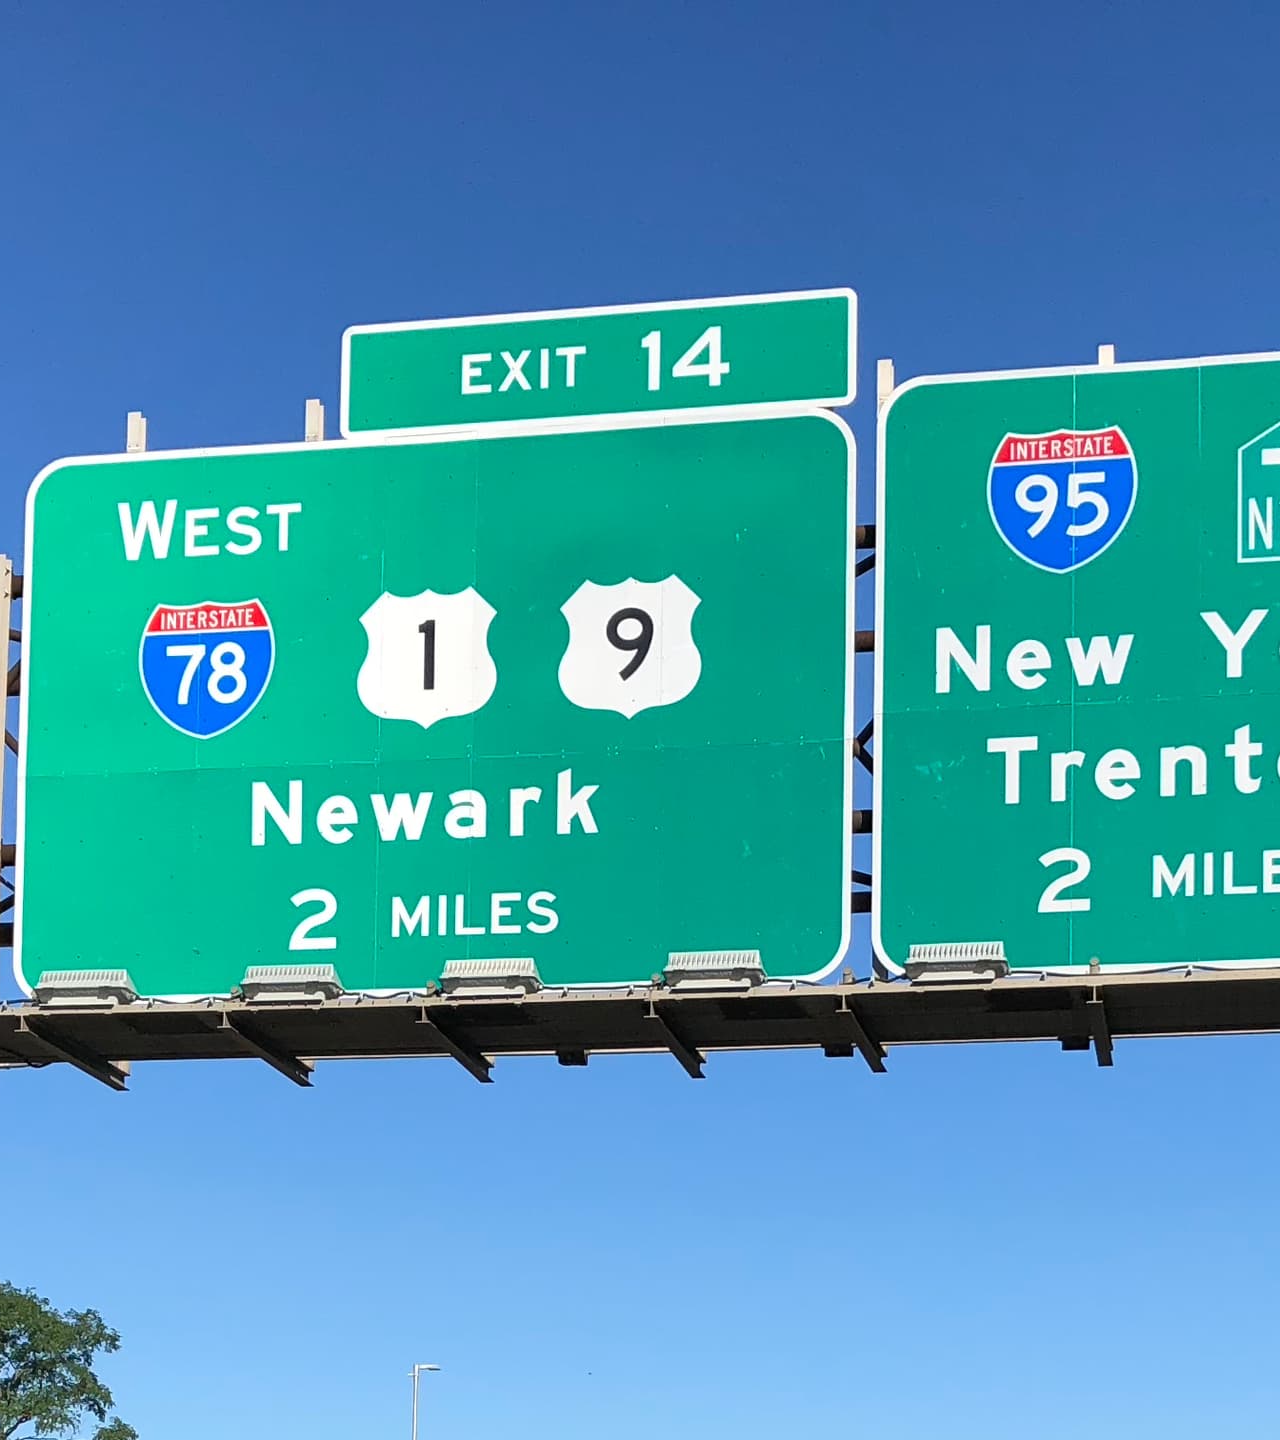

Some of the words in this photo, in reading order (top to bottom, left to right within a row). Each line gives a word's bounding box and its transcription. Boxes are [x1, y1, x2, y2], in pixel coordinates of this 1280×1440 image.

[462, 347, 586, 394] EXIT
[642, 327, 730, 391] 14
[1009, 436, 1114, 461] INTERSTATE
[118, 500, 302, 560] WEST
[1014, 471, 1110, 538] 95
[160, 607, 255, 630] INTERSTATE
[166, 641, 248, 705] 78
[419, 619, 435, 690] 1
[606, 607, 654, 681] 9
[935, 625, 1134, 694] New
[251, 768, 600, 846] Newark
[1037, 847, 1091, 913] 2
[289, 888, 337, 951] 2
[391, 891, 559, 938] MILES
